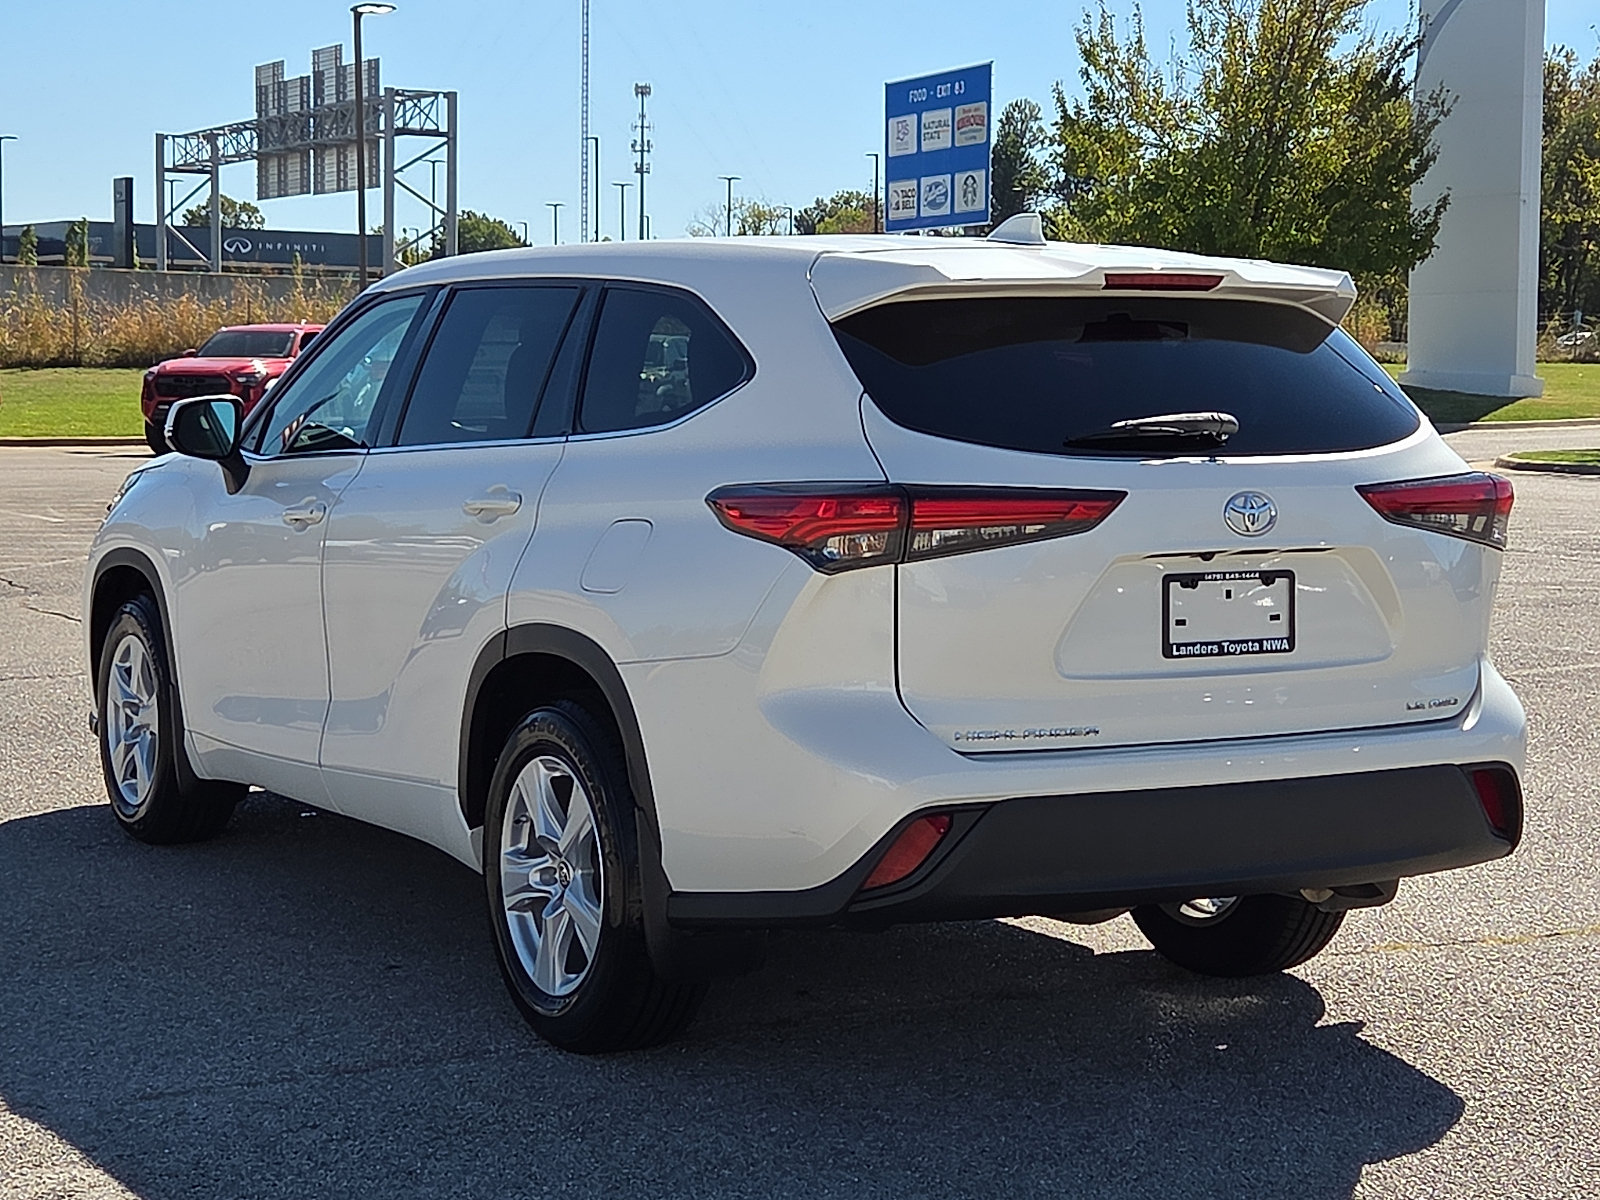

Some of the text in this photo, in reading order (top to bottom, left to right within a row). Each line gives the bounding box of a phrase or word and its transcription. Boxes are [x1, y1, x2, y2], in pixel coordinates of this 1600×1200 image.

[909, 88, 927, 103] FOOD
[937, 83, 951, 98] EXIT
[923, 120, 950, 130] NATURAL
[923, 131, 941, 141] STATE
[900, 187, 916, 199] TACO
[901, 199, 916, 210] BELL
[258, 242, 325, 252] INFINITI
[1172, 638, 1289, 656] Landers Toyota NWA
